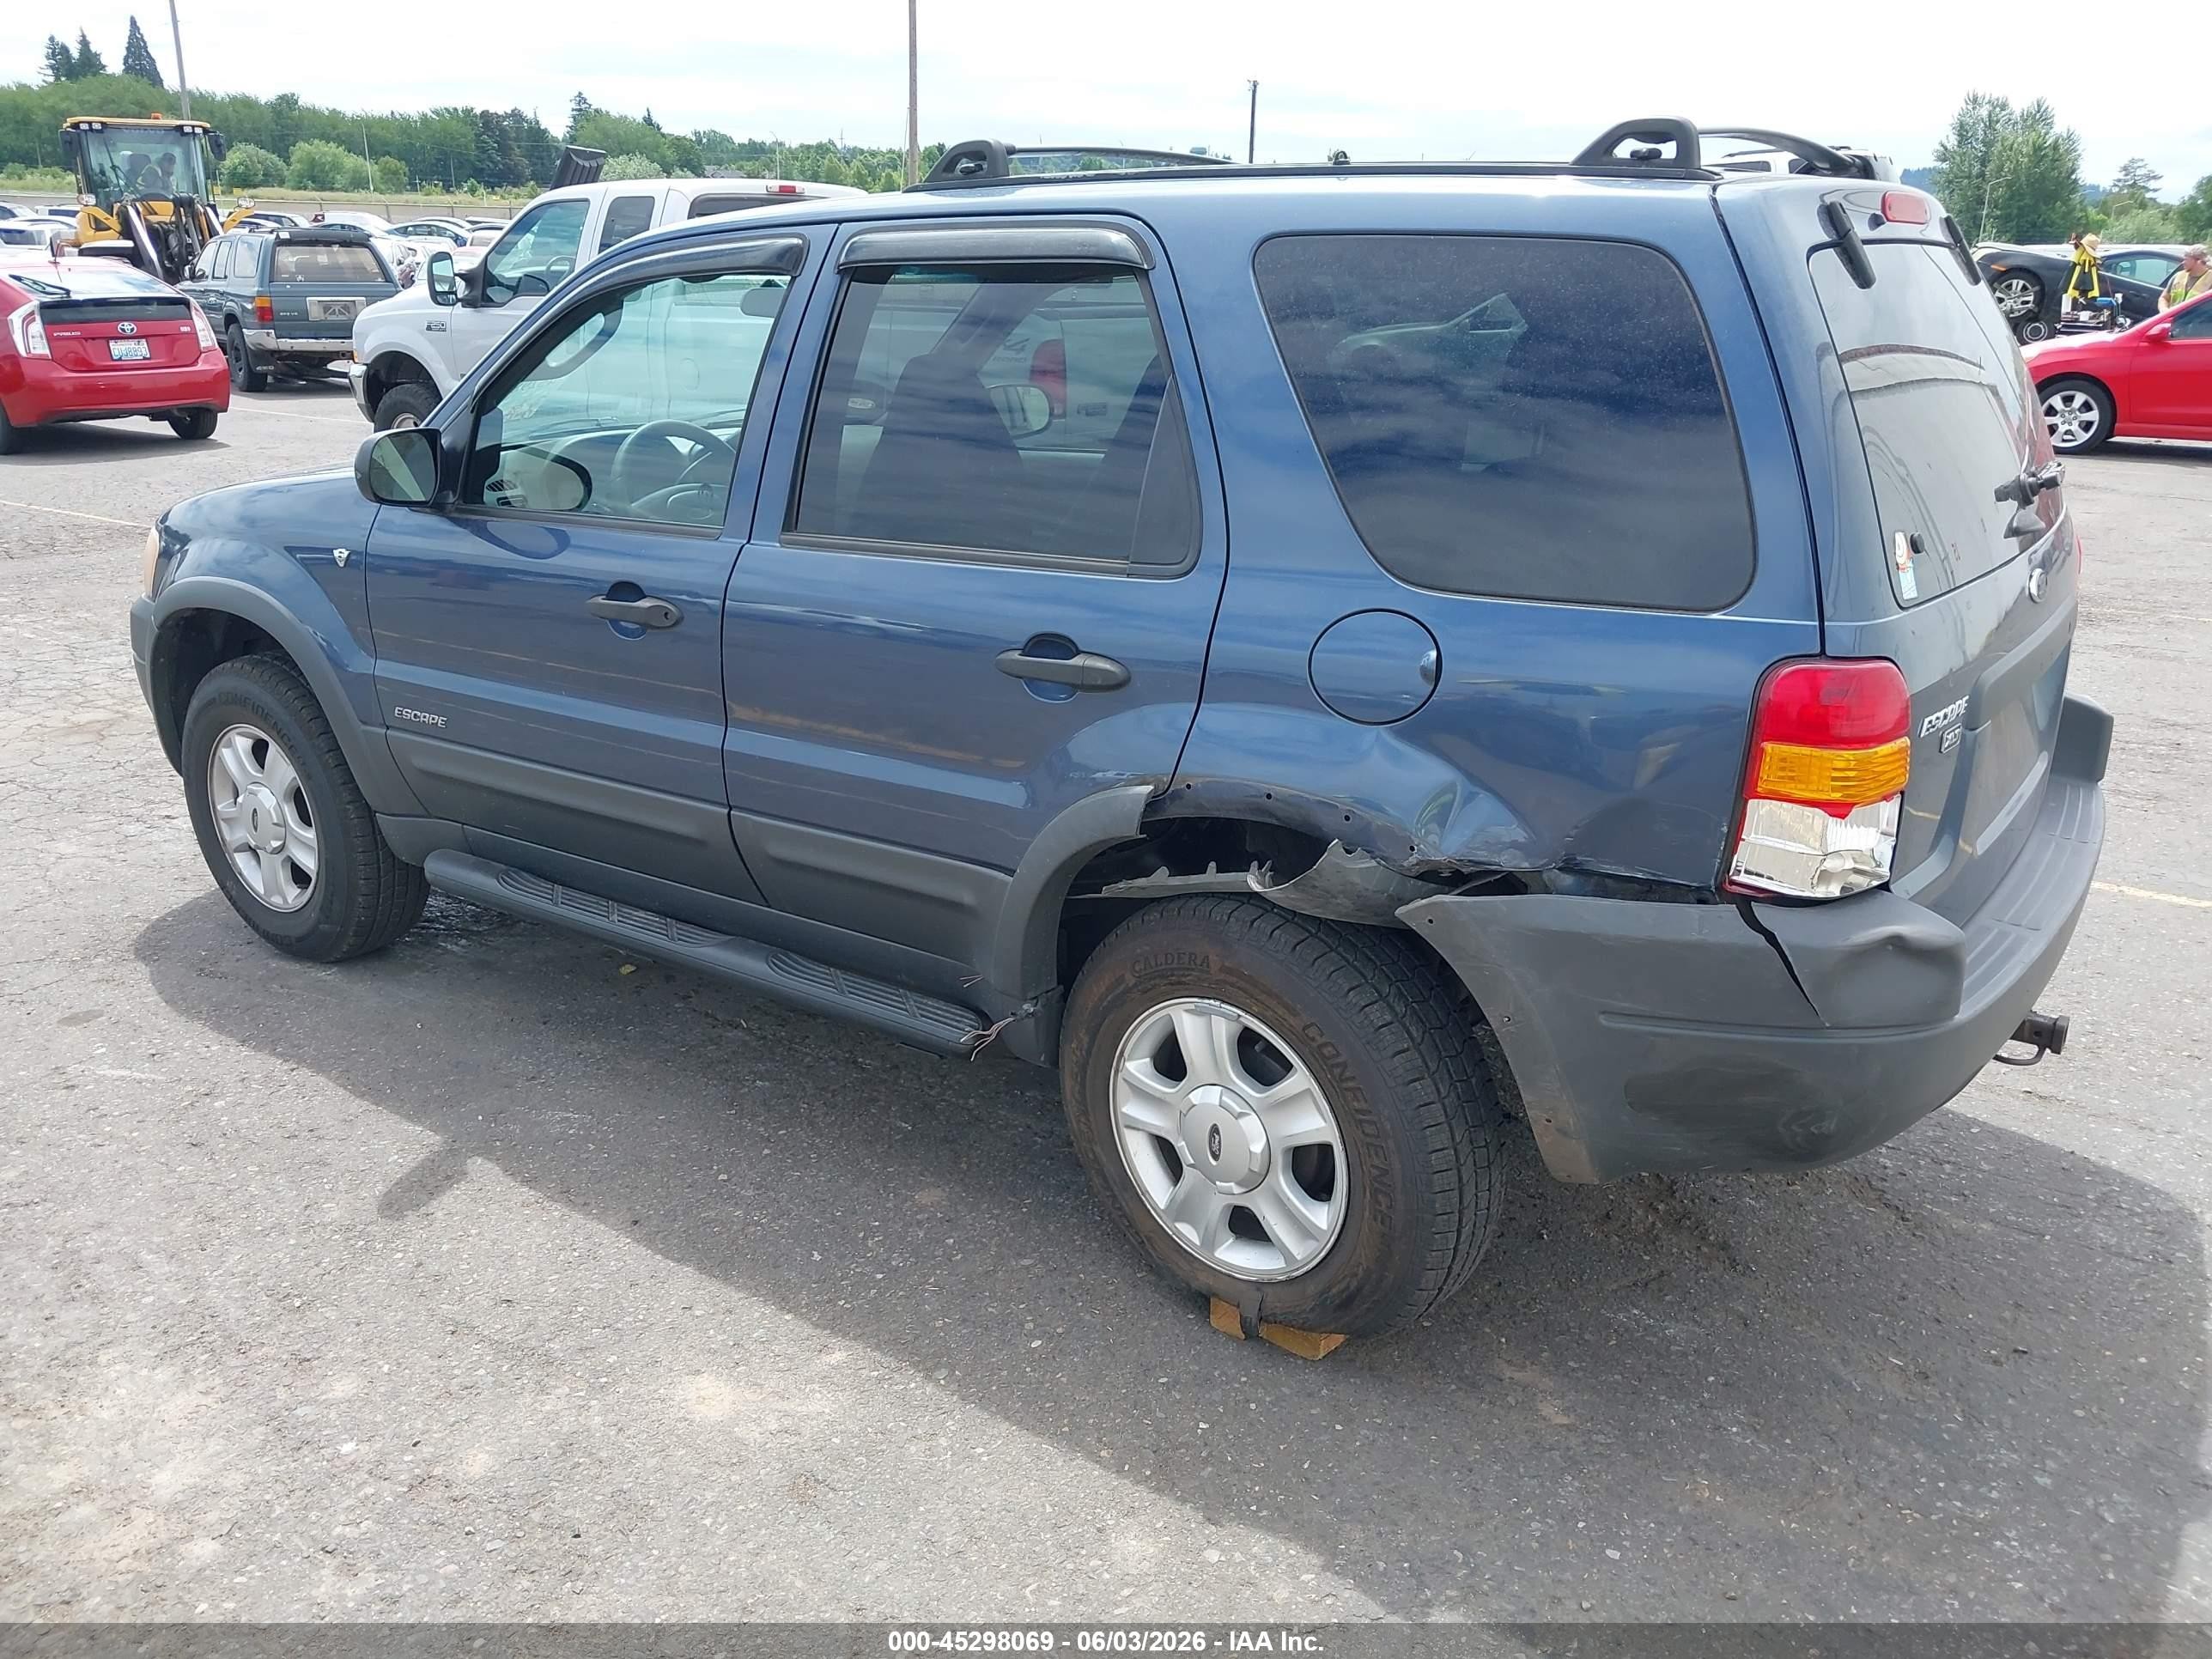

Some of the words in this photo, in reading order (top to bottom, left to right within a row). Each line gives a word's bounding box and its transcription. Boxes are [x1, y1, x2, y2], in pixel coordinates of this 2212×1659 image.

[394, 706, 447, 728] ESCAPE
[1920, 695, 1970, 738] ESCAPE
[1132, 951, 1210, 976] CALDERA
[1302, 1021, 1394, 1231] CONFIDENCE
